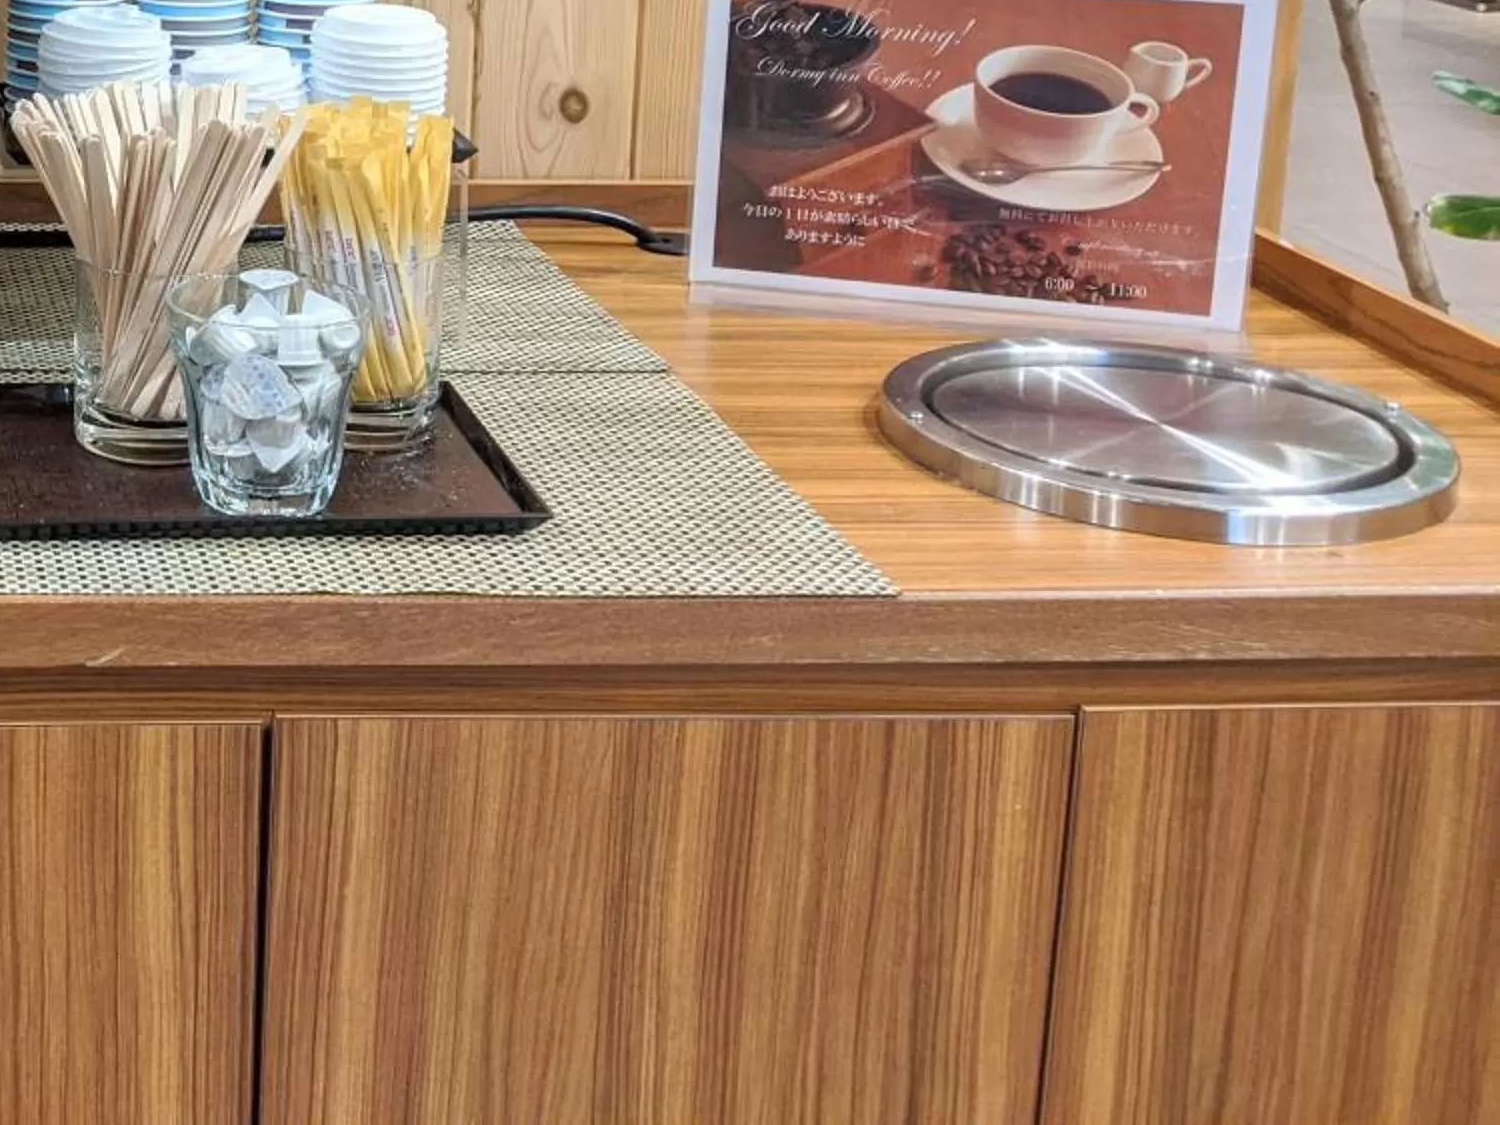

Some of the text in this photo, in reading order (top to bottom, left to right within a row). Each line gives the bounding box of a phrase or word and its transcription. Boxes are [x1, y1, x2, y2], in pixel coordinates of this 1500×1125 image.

[735, 2, 977, 58] Good Morning!
[784, 227, 867, 246] ありますように
[1044, 277, 1075, 292] 6:00
